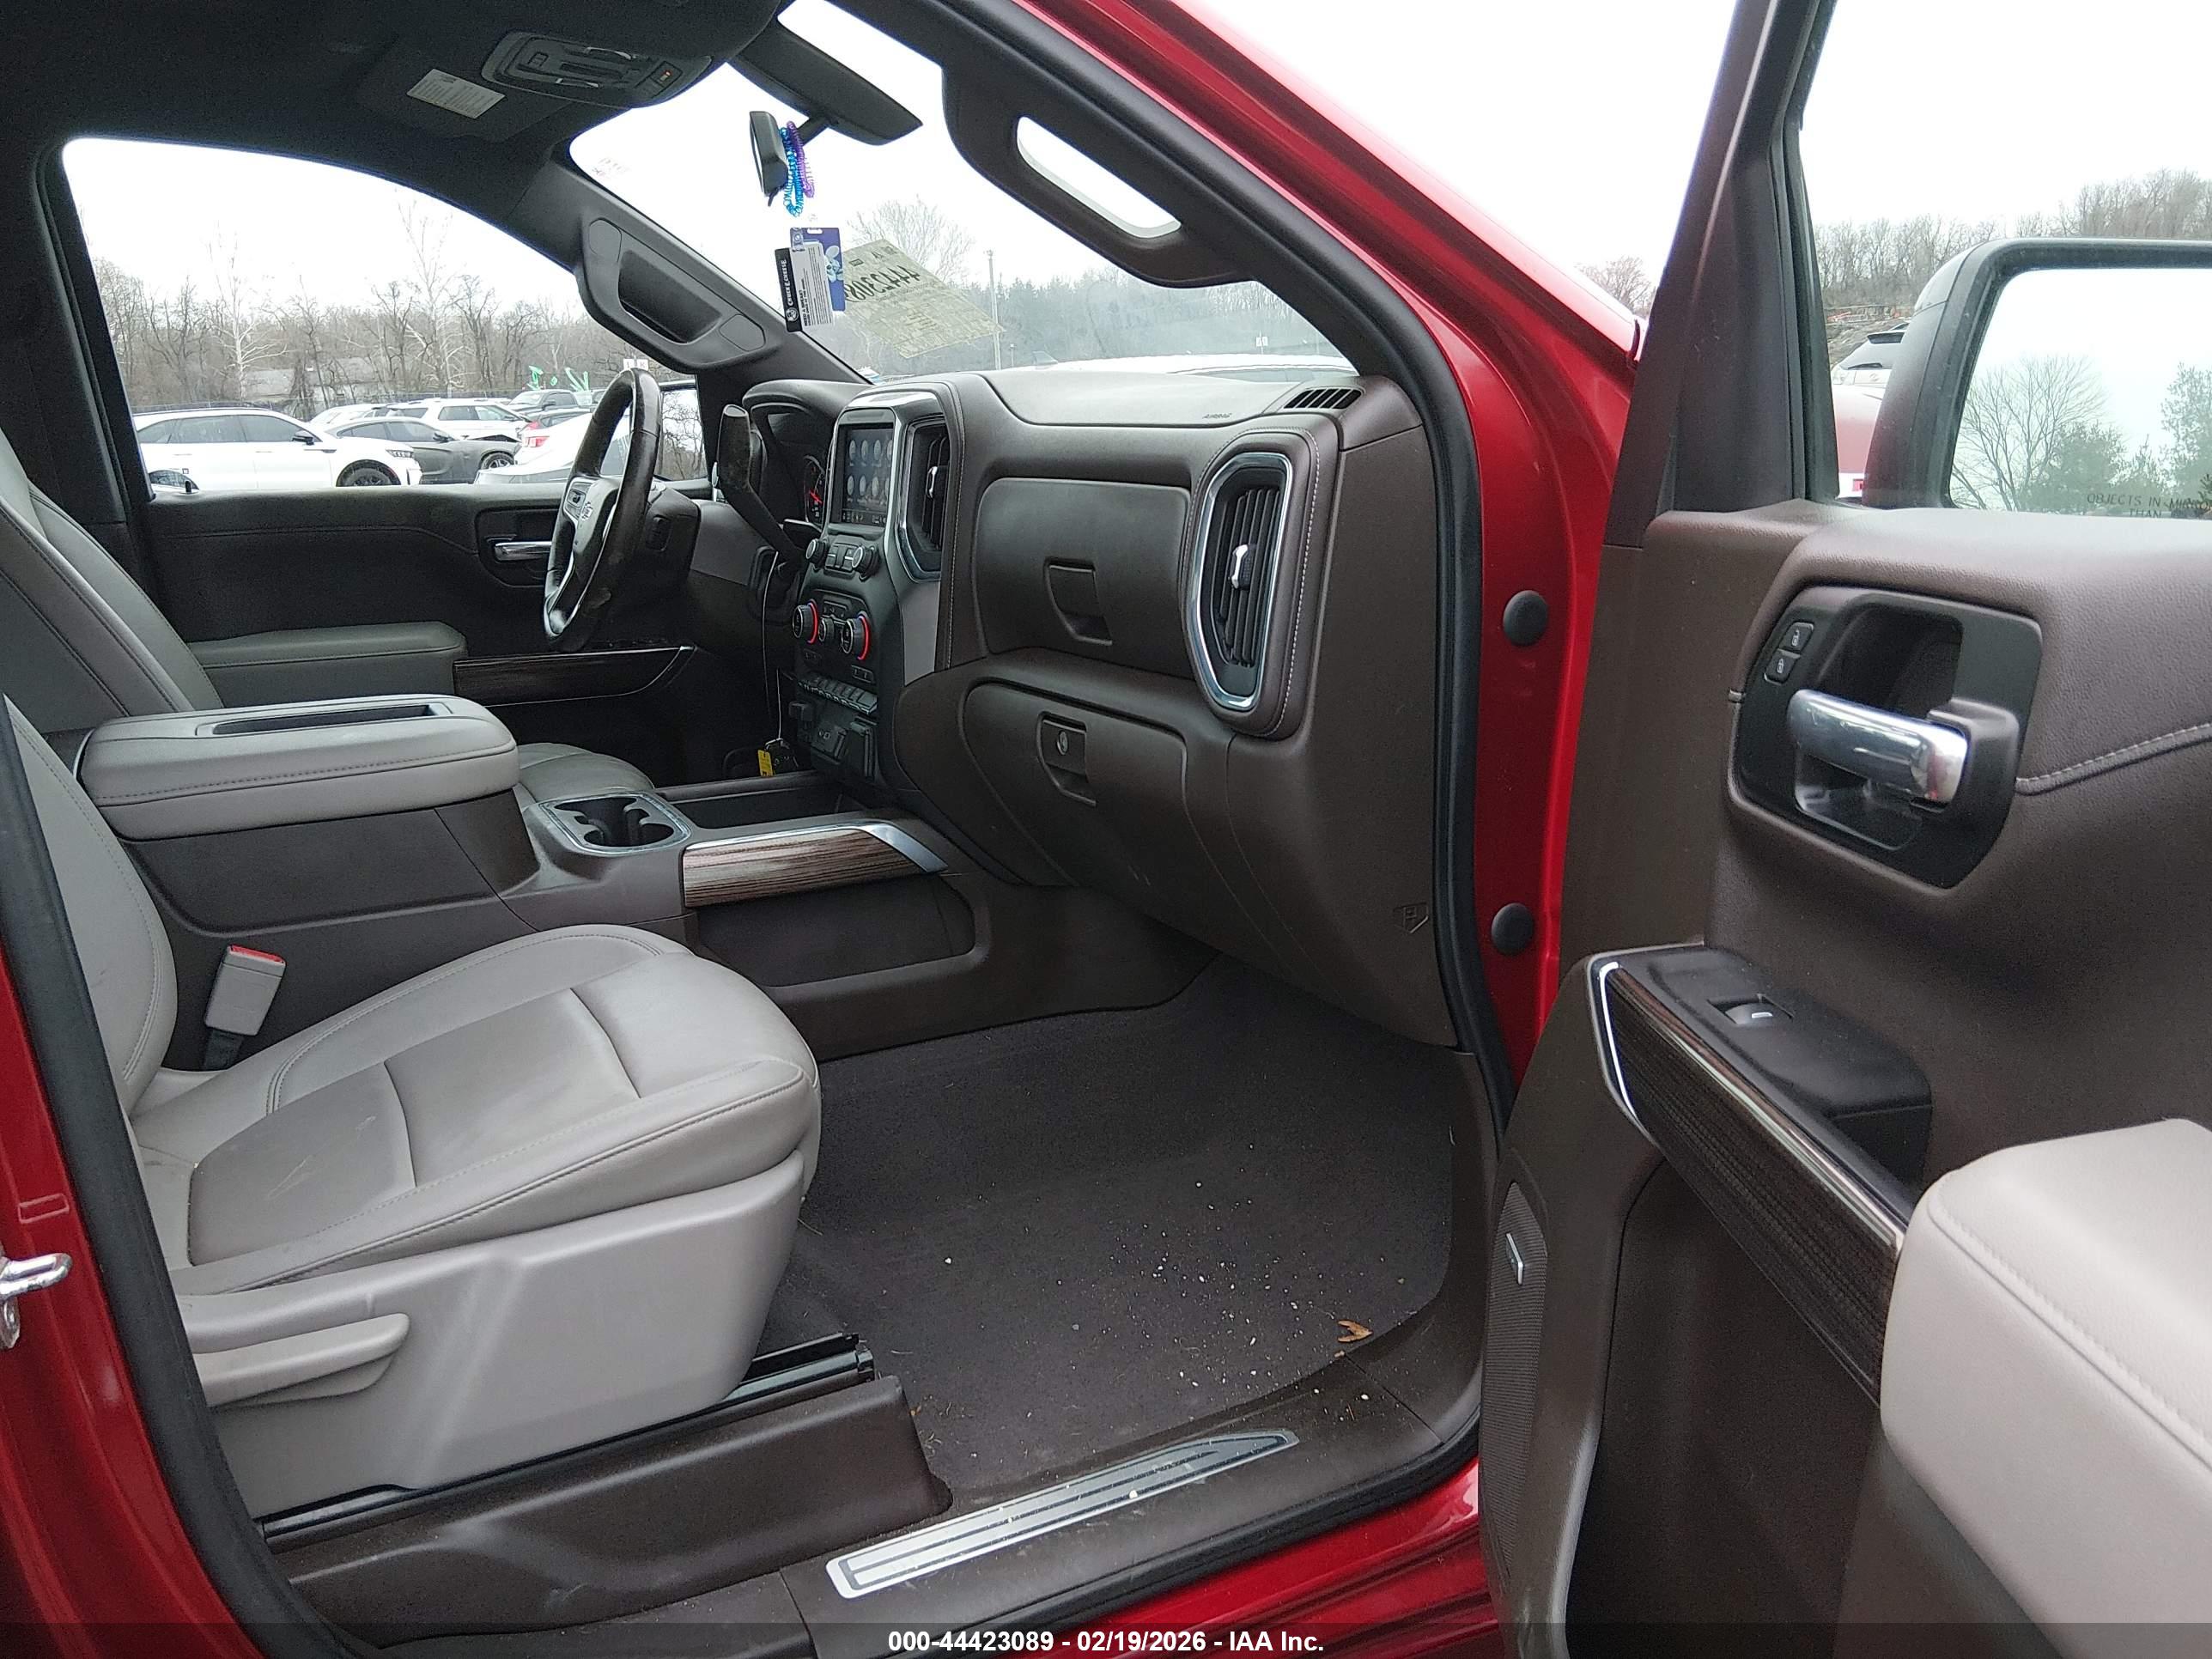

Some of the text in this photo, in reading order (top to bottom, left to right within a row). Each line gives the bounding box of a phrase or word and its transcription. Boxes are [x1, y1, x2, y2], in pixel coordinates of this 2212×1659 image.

[2087, 493, 2142, 506] OBJECTS
[2148, 496, 2161, 507] IN
[2129, 508, 2162, 518] THAN
